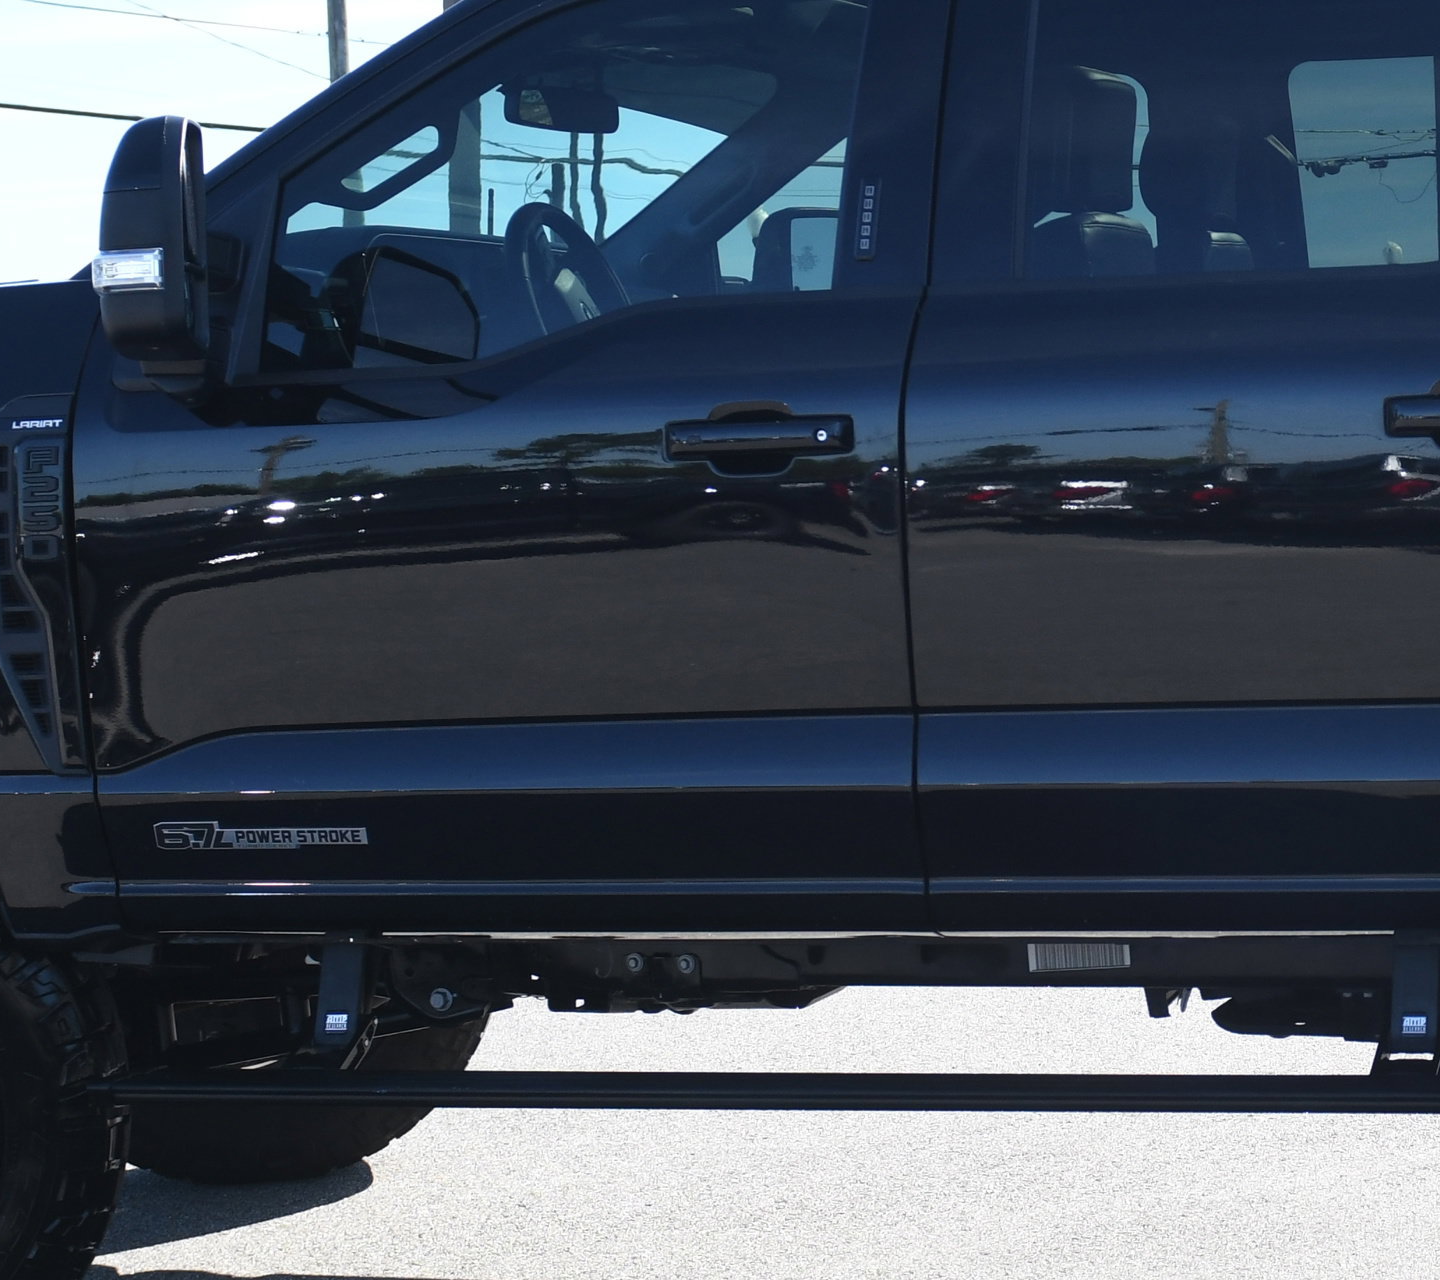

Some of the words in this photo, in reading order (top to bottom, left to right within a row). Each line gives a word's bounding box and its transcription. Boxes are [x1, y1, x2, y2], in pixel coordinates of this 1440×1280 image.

[11, 418, 63, 430] LARIAT
[235, 829, 292, 844] POWER
[296, 828, 362, 844] STROKE
